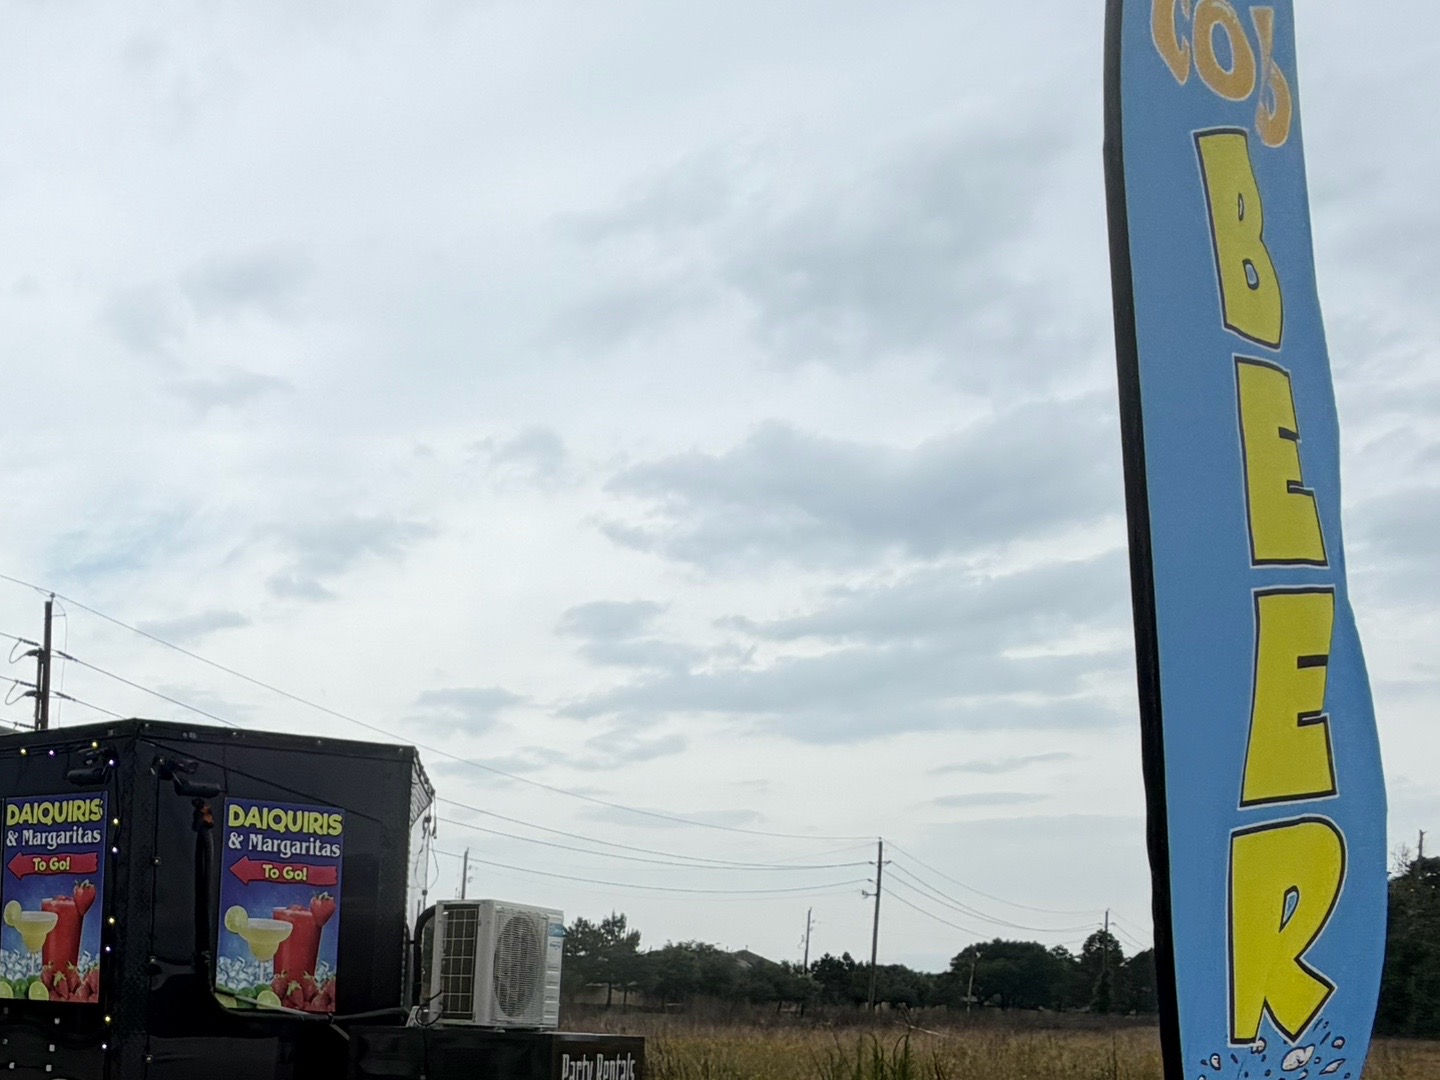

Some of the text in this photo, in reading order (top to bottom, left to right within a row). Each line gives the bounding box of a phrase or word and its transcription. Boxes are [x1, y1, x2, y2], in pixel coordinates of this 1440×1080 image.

[1192, 127, 1348, 1047] BEER
[6, 798, 103, 826] DAIQUIRIS
[228, 804, 343, 836] DAIQUIRIS
[6, 830, 19, 847] &
[22, 826, 101, 850] Margaritas
[228, 832, 341, 858] & Margaritas
[33, 856, 71, 872] To Go!
[262, 864, 308, 881] To Go!
